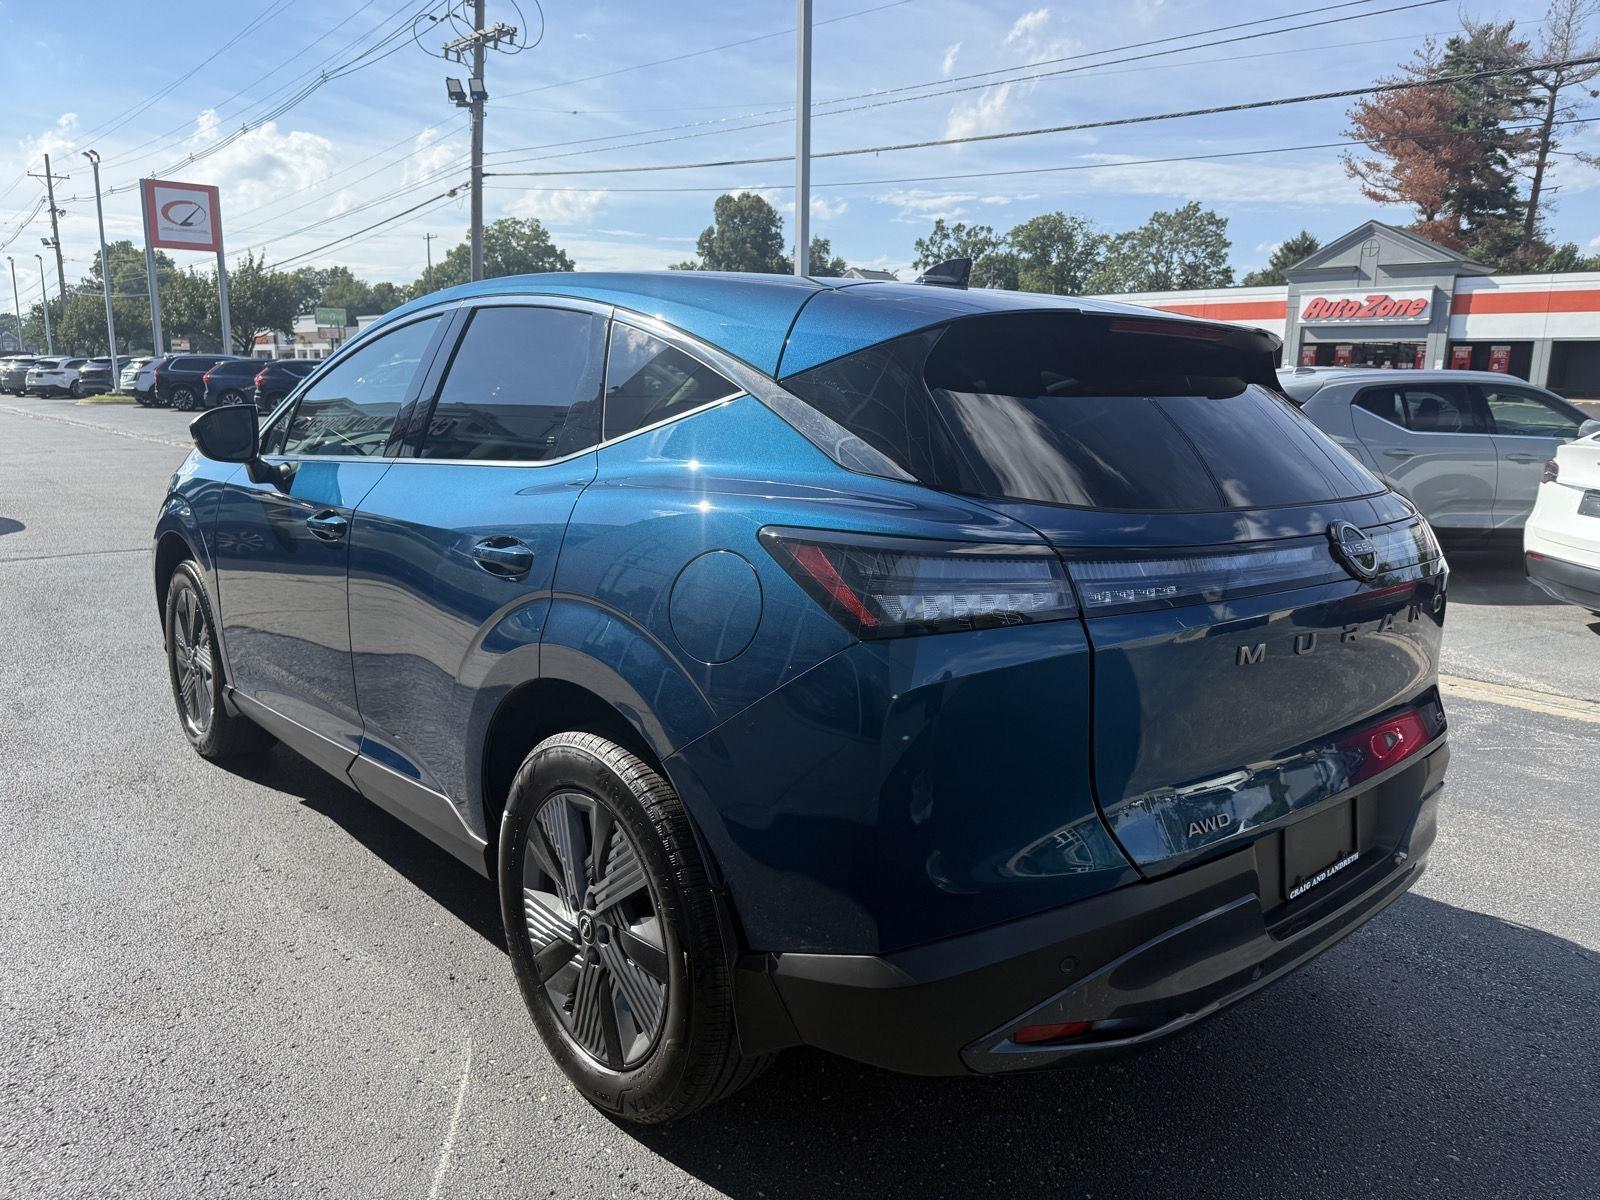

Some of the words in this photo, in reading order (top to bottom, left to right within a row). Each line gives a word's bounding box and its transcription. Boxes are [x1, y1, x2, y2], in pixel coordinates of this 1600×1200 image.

[1301, 294, 1429, 320] AutoZone
[1342, 542, 1373, 554] NISS
[1236, 594, 1442, 666] MURANO
[1188, 813, 1231, 838] AWD
[1289, 881, 1311, 899] CRAIG
[1311, 872, 1327, 887] AND
[1326, 852, 1359, 878] LANDRETH
